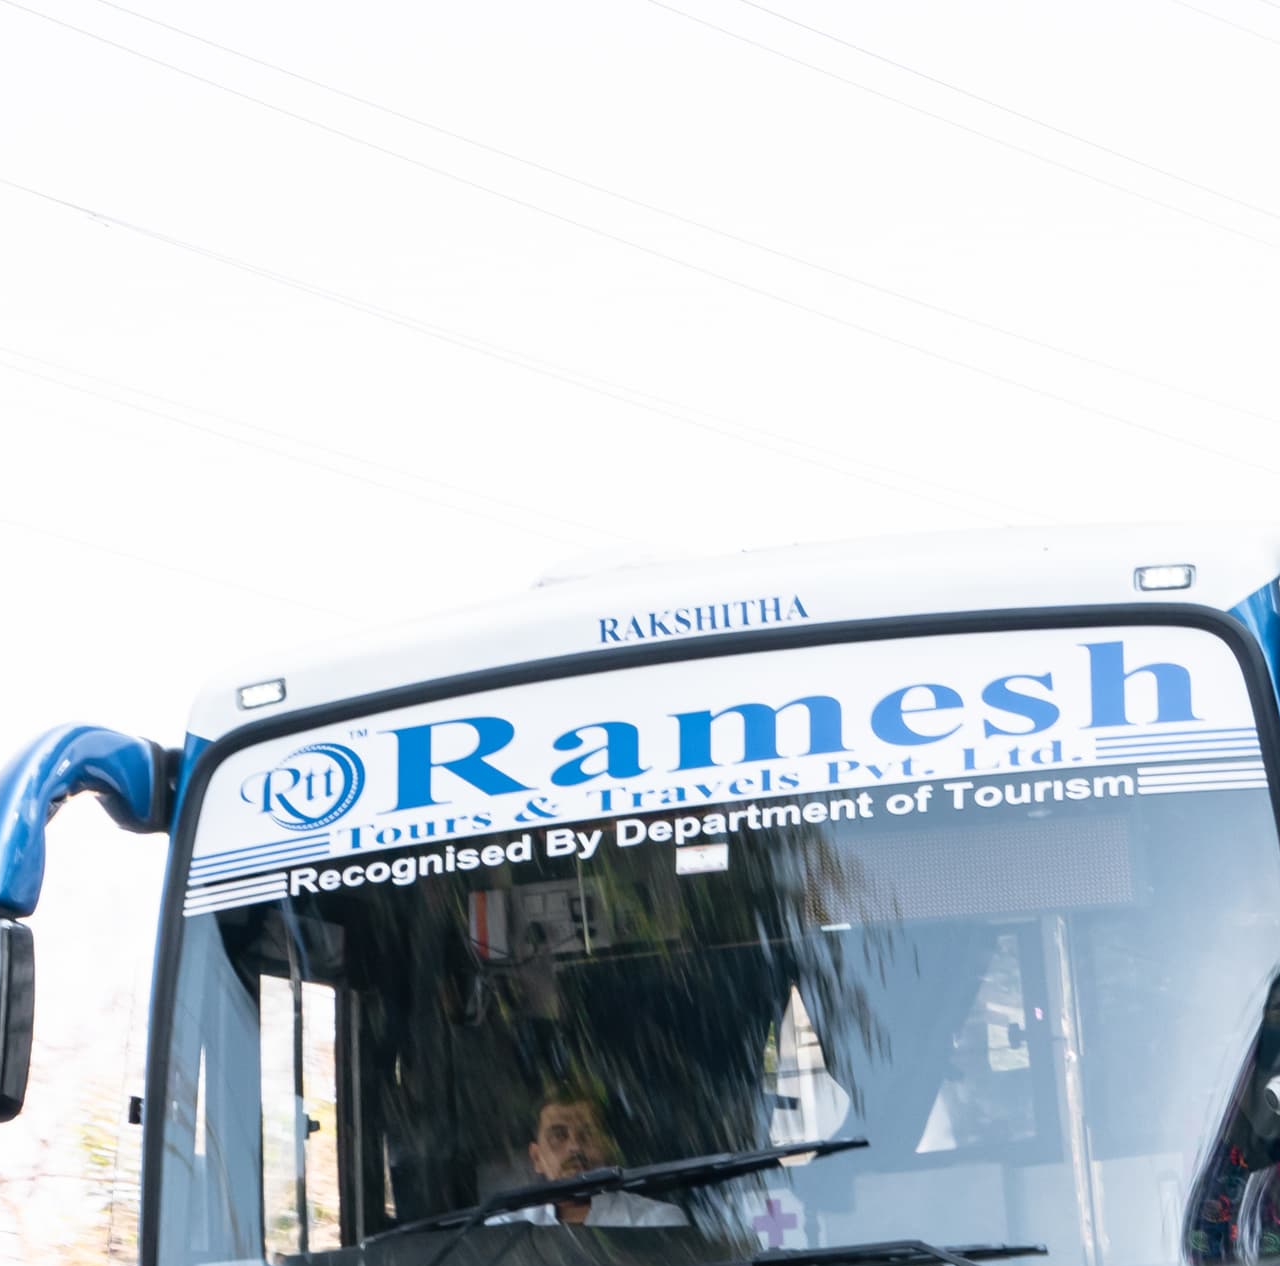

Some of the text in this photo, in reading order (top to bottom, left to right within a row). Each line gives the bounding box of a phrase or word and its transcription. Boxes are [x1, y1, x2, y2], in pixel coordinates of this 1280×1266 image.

[597, 594, 809, 643] RAKSHITHA
[376, 639, 1205, 816] Ramesh
[289, 771, 1136, 897] Recognised By Department of Tourism
[337, 739, 1083, 850] Tours & Travels Pvt. Ltd.
